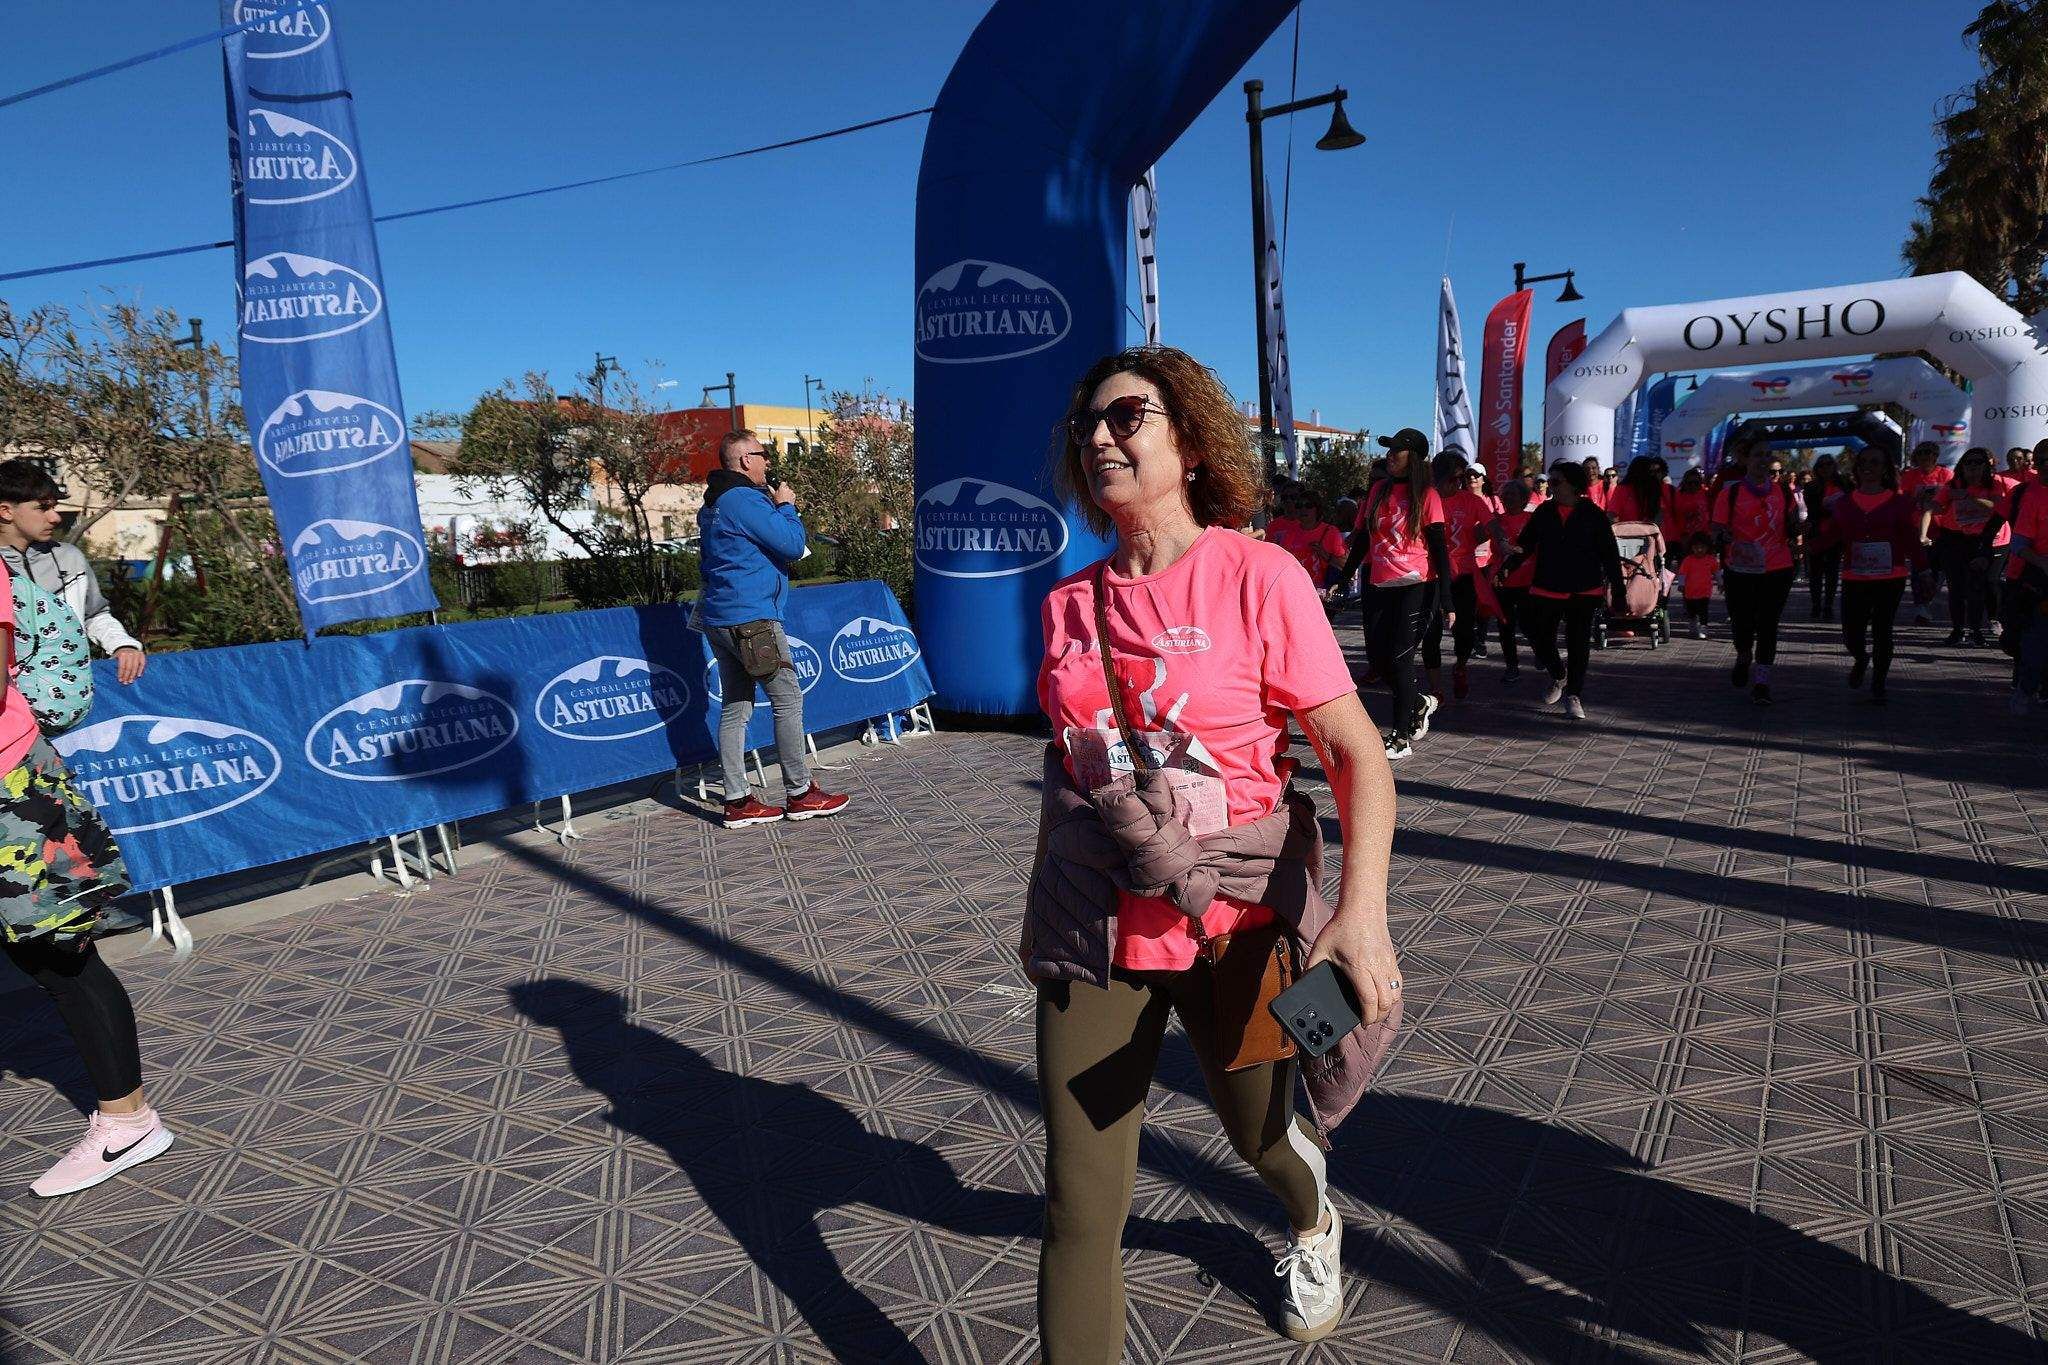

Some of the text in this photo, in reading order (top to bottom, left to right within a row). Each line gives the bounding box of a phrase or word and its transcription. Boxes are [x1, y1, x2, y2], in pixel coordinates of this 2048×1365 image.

[927, 293, 1050, 311] CENTRAL LECHERA
[915, 305, 1058, 344] ASTURIANA
[1684, 298, 1886, 351] OYSHO
[1949, 325, 2017, 343] OYSHO
[1496, 319, 1518, 410] Santander
[1574, 364, 1628, 378] OYSHO
[1984, 403, 2048, 421] OYSHO
[1550, 433, 1599, 447] OYSHO
[927, 511, 1047, 523] CENTRAL LECHERA
[915, 513, 1054, 552] ASTURIANA
[839, 640, 917, 671] ASTURIANA
[570, 682, 621, 698] CENTRAL
[355, 702, 494, 732] CENTRAL LECHERA
[552, 686, 684, 728] ASTURIANA
[161, 741, 249, 762] LECHERA
[328, 714, 509, 767] ASTURIANA
